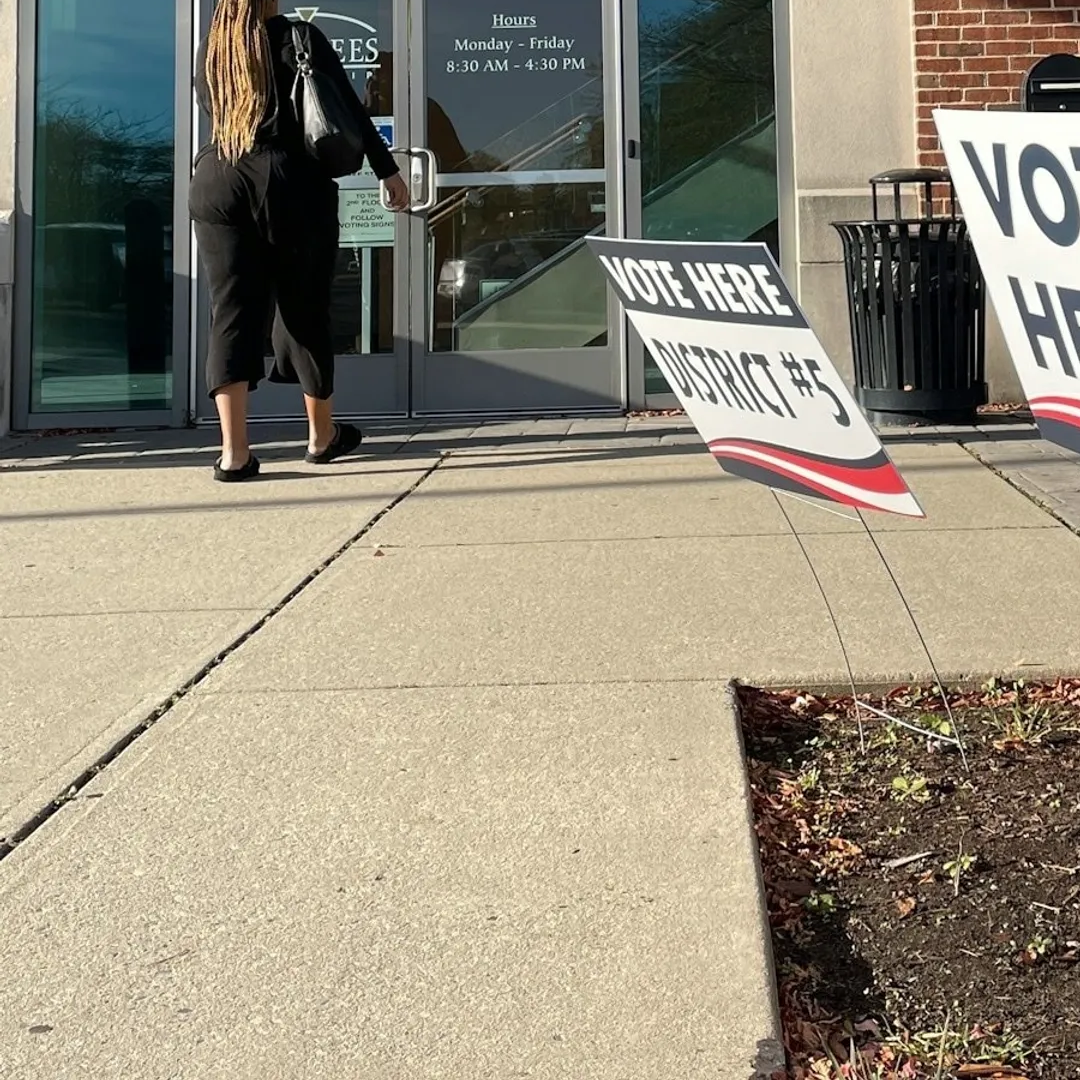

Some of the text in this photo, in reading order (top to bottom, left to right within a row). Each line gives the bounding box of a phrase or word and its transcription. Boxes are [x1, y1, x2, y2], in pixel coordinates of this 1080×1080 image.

[492, 13, 537, 28] Hours
[453, 37, 514, 53] Monday
[529, 36, 575, 52] Friday
[446, 59, 479, 73] 8:30
[483, 59, 509, 72] AM
[524, 58, 558, 71] 4:30
[562, 57, 586, 70] PM
[598, 255, 794, 317] VOTE HERE
[649, 337, 851, 428] DISTRICT #5
